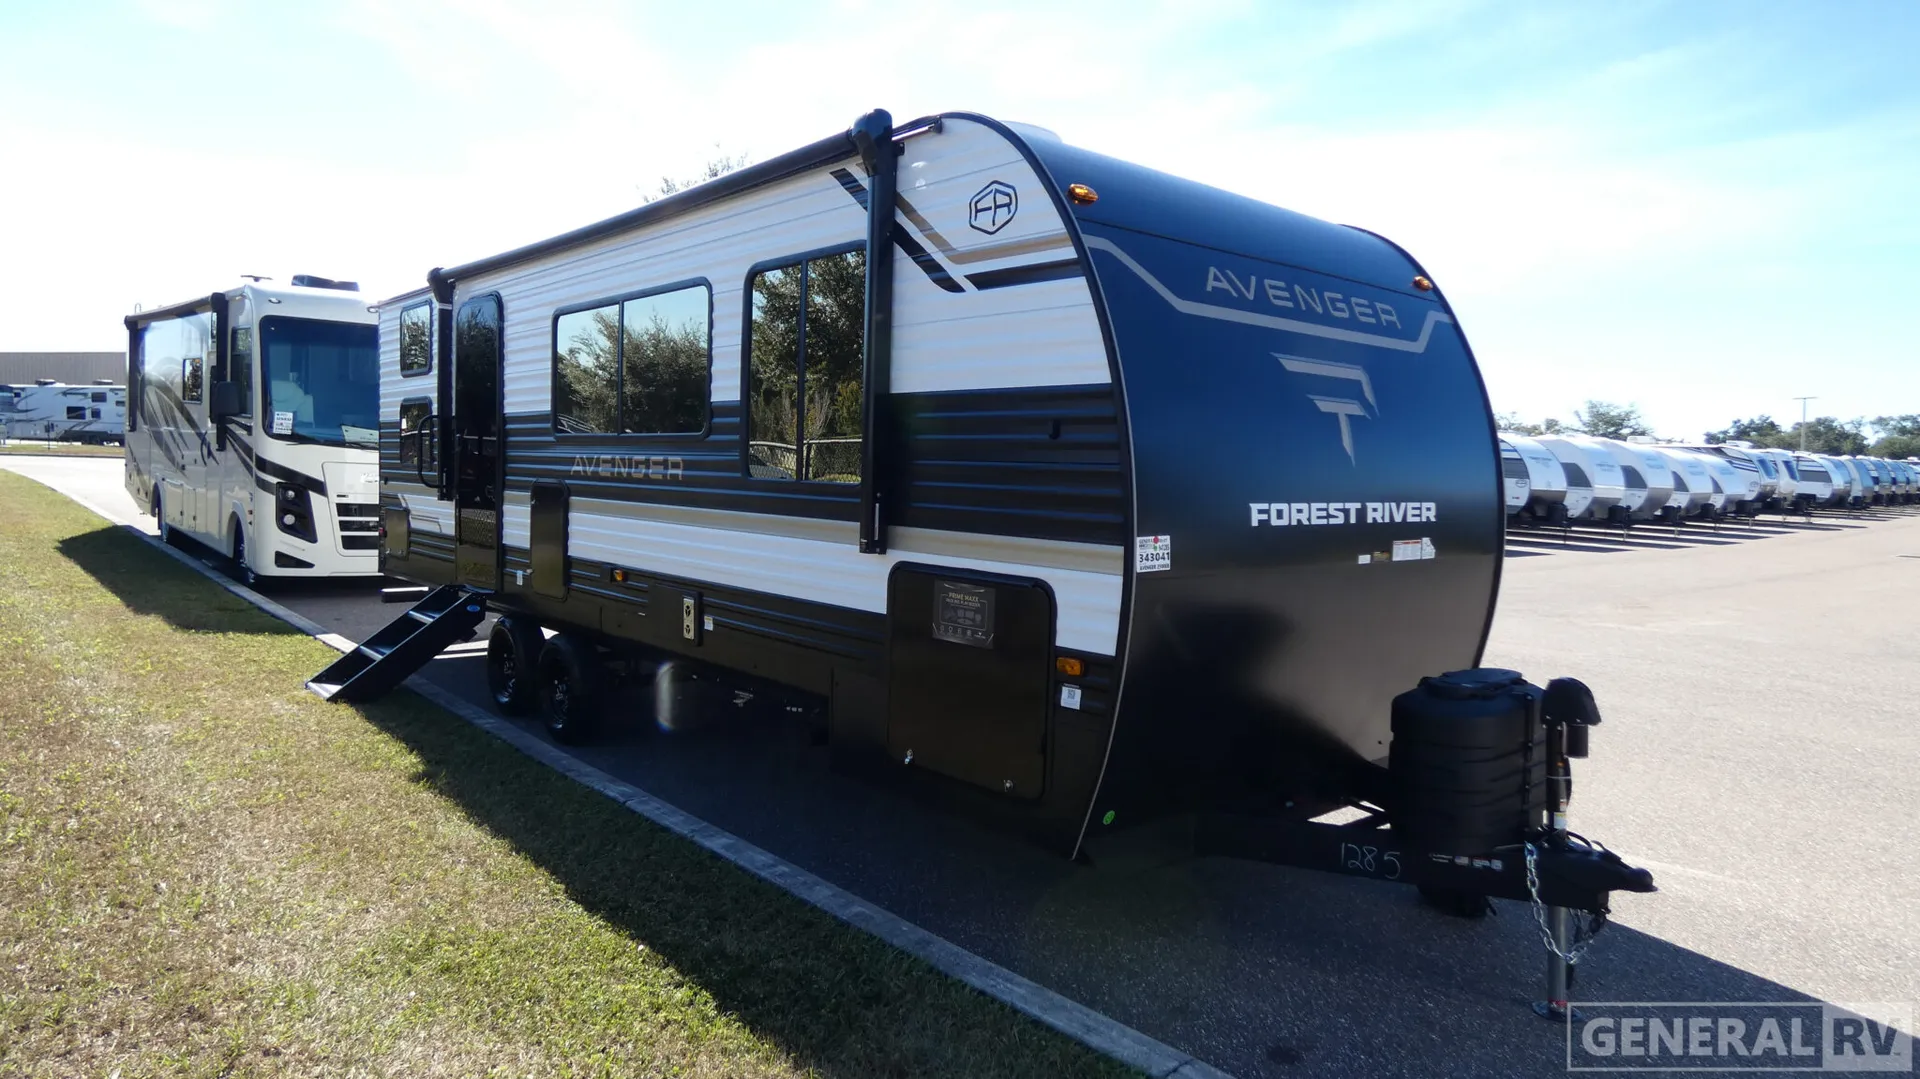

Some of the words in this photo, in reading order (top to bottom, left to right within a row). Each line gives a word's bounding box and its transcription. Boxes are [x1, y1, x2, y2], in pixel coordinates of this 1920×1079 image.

[1206, 266, 1402, 329] AVENGER
[570, 455, 684, 481] AVENGER
[1249, 502, 1362, 527] FOREST
[1367, 502, 1437, 524] RIVER
[1139, 552, 1170, 563] 343041
[1339, 842, 1402, 880] 1285
